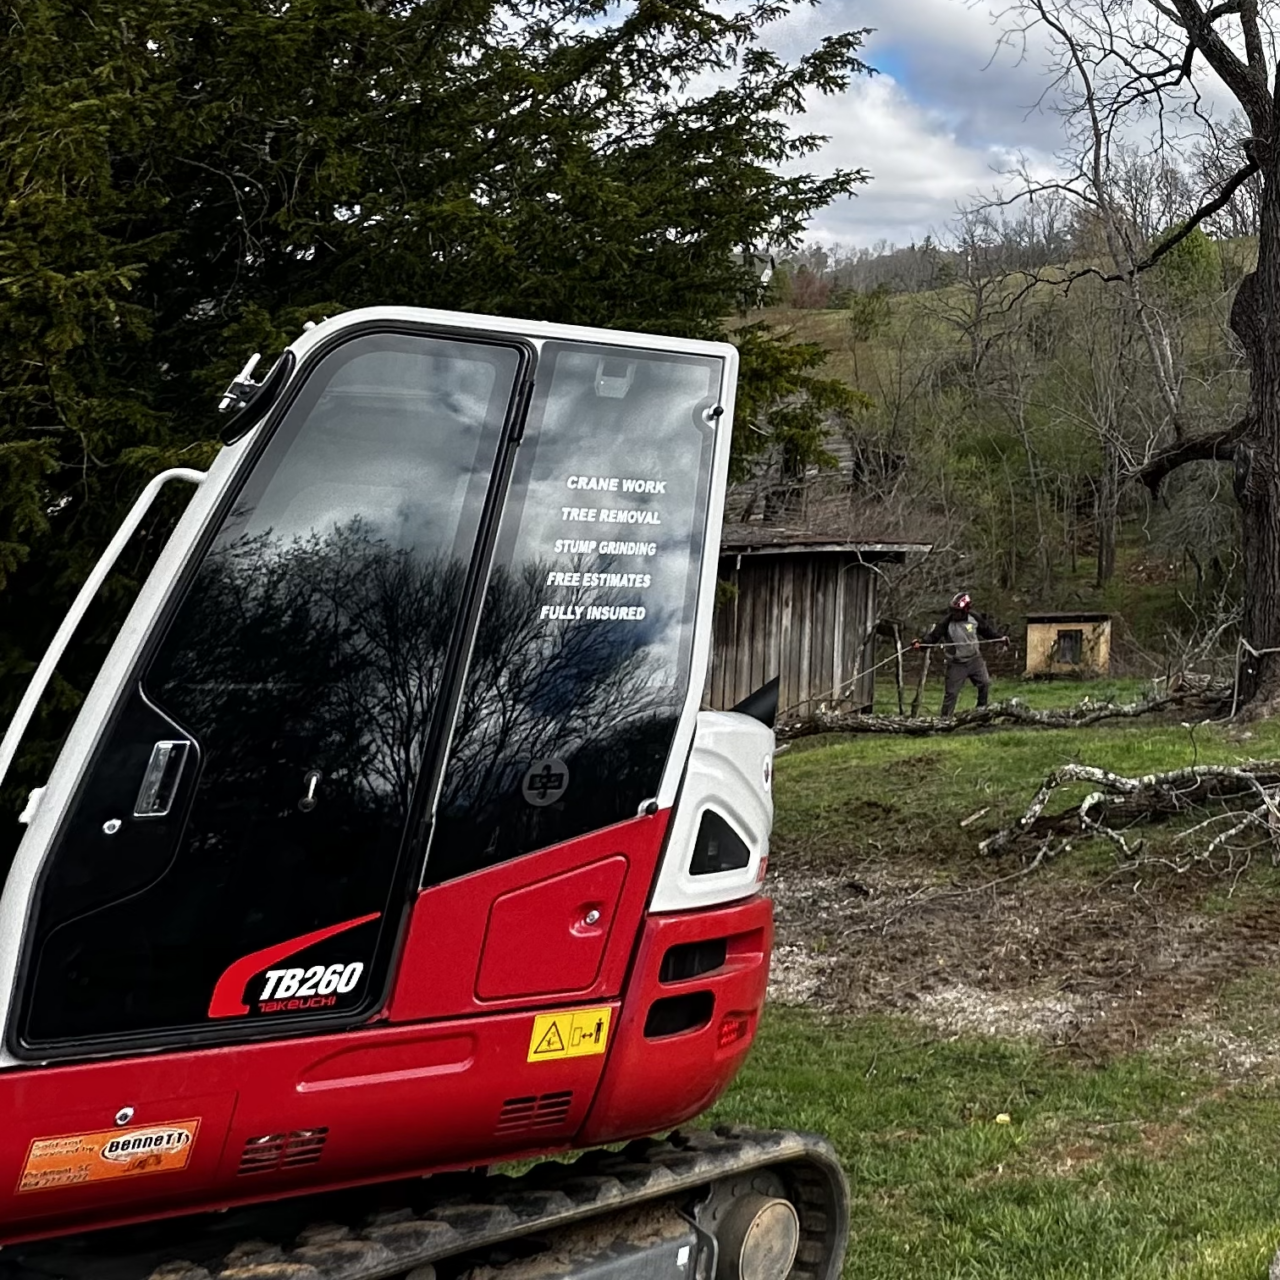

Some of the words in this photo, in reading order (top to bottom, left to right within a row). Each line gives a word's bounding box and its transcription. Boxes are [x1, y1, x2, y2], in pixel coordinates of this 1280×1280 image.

[567, 476, 619, 491] CRANE
[622, 479, 667, 493] WORK
[562, 507, 597, 522] TREE
[599, 509, 661, 524] REMOVAL
[554, 539, 597, 554] STUMP
[599, 541, 657, 556] GRINDING
[547, 572, 580, 586] FREE
[583, 573, 652, 588] ESTIMATES
[540, 605, 585, 620] FULLY
[586, 606, 646, 620] INSURED
[259, 962, 364, 1001] TB260
